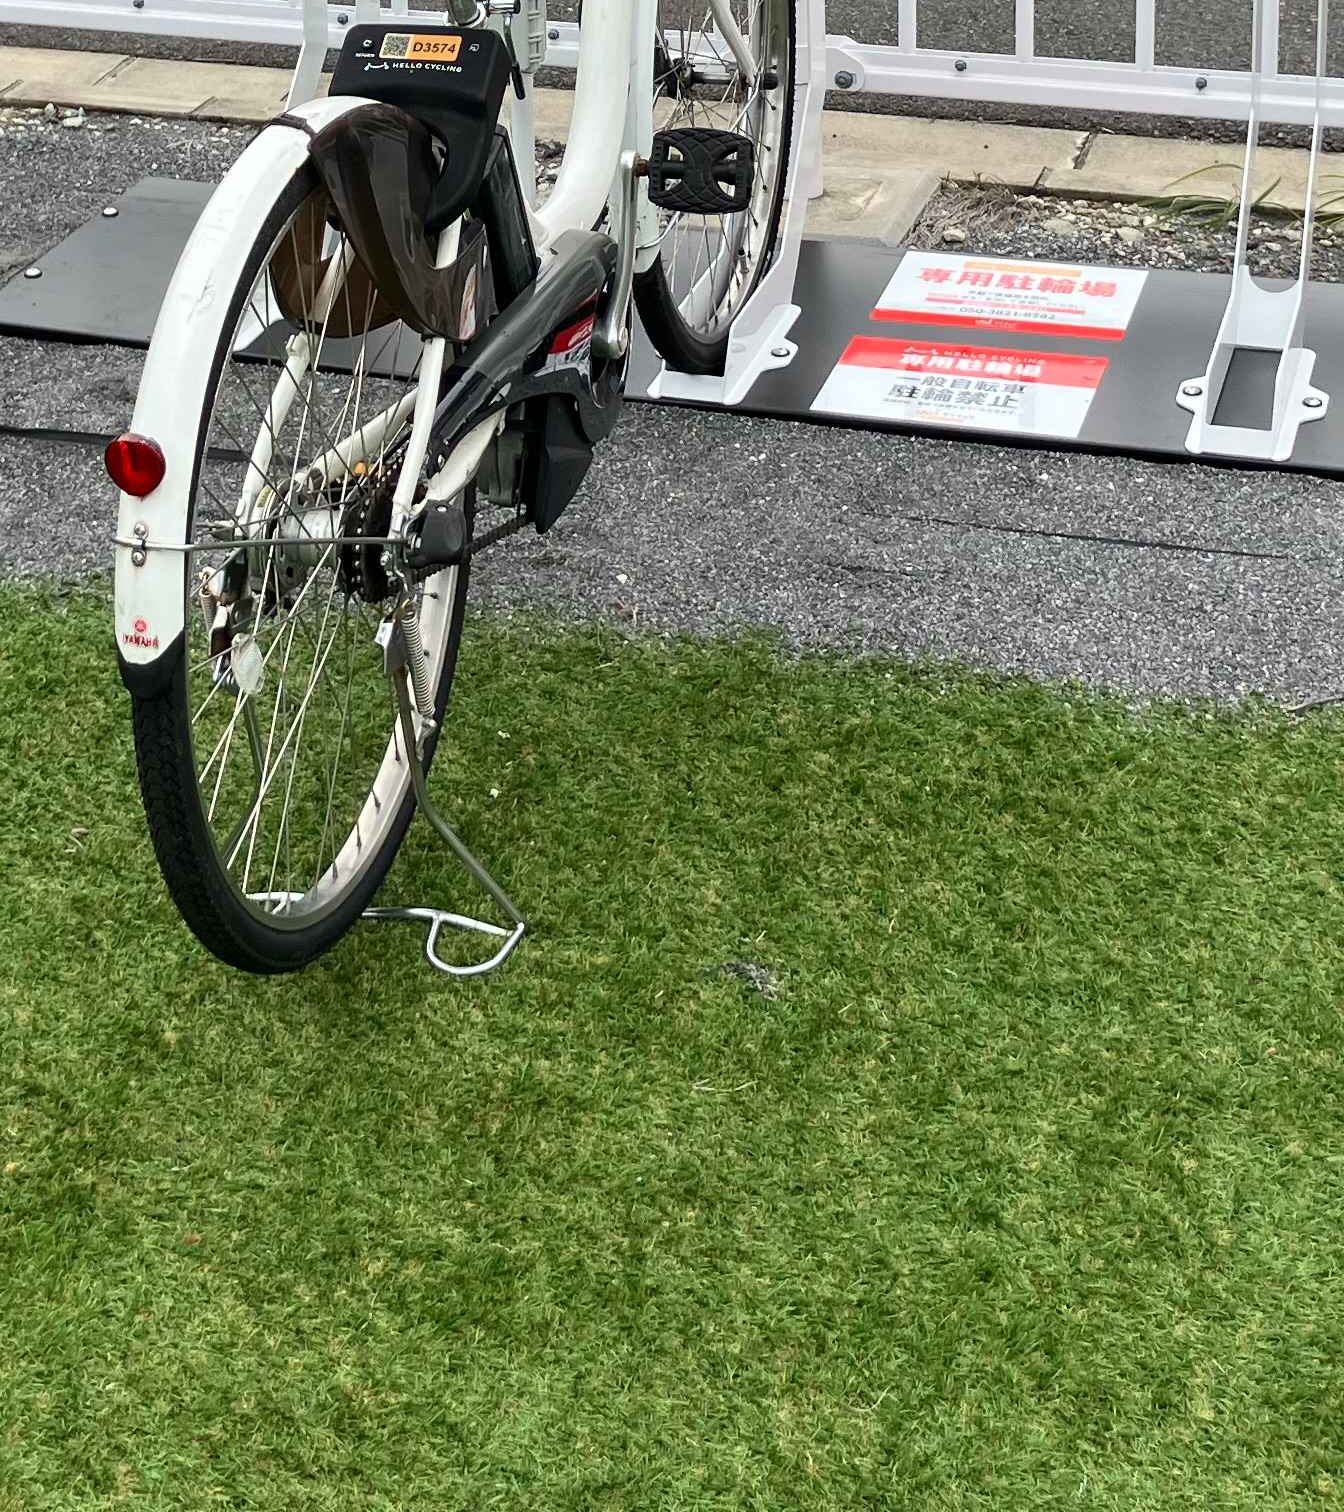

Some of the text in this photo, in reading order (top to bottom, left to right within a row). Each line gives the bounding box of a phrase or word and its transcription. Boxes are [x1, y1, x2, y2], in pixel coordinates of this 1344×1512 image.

[412, 40, 457, 54] D3574
[424, 63, 463, 73] CYCLING
[918, 267, 1118, 298] 専用駐輪場
[895, 375, 1027, 394] 一般自転車
[887, 384, 1020, 410] 駐輪禁止
